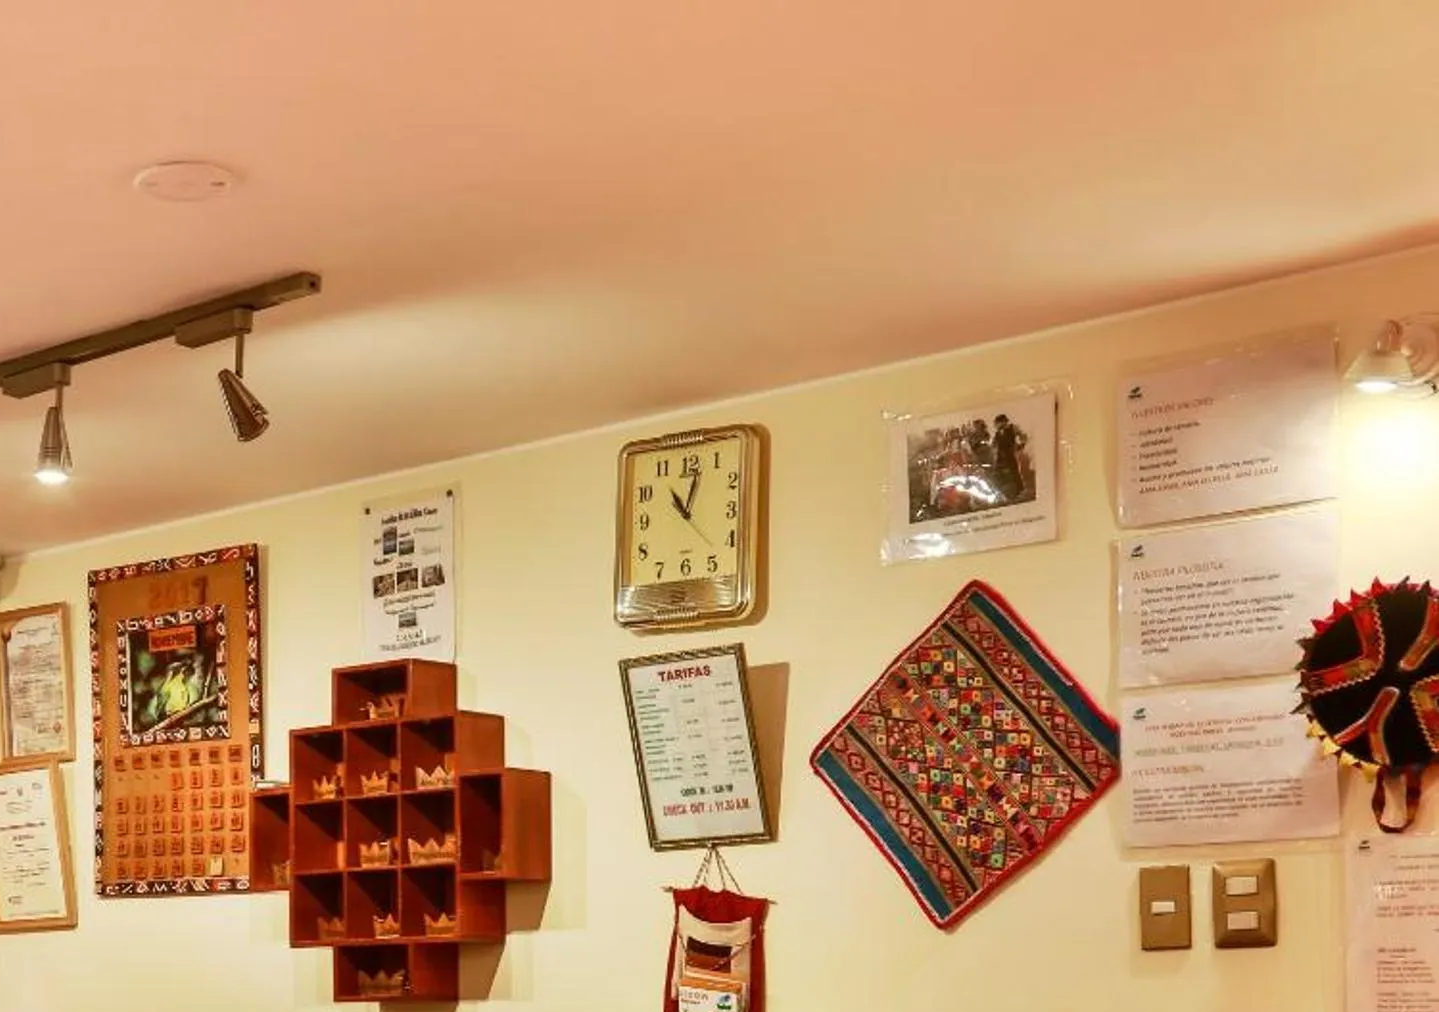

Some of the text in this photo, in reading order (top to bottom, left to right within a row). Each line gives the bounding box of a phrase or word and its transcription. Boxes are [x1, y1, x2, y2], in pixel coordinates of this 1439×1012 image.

[656, 460, 669, 477] 11
[679, 455, 701, 478] 12
[713, 452, 720, 469] 1
[728, 472, 737, 490] 2
[638, 485, 653, 503] 10
[726, 501, 737, 519] 3
[640, 513, 650, 532] 9
[725, 530, 735, 548] 4
[638, 543, 648, 561] 8
[655, 561, 664, 579] 7
[680, 558, 691, 576] 6
[707, 555, 718, 572] 5
[658, 665, 711, 682] TARIFAS
